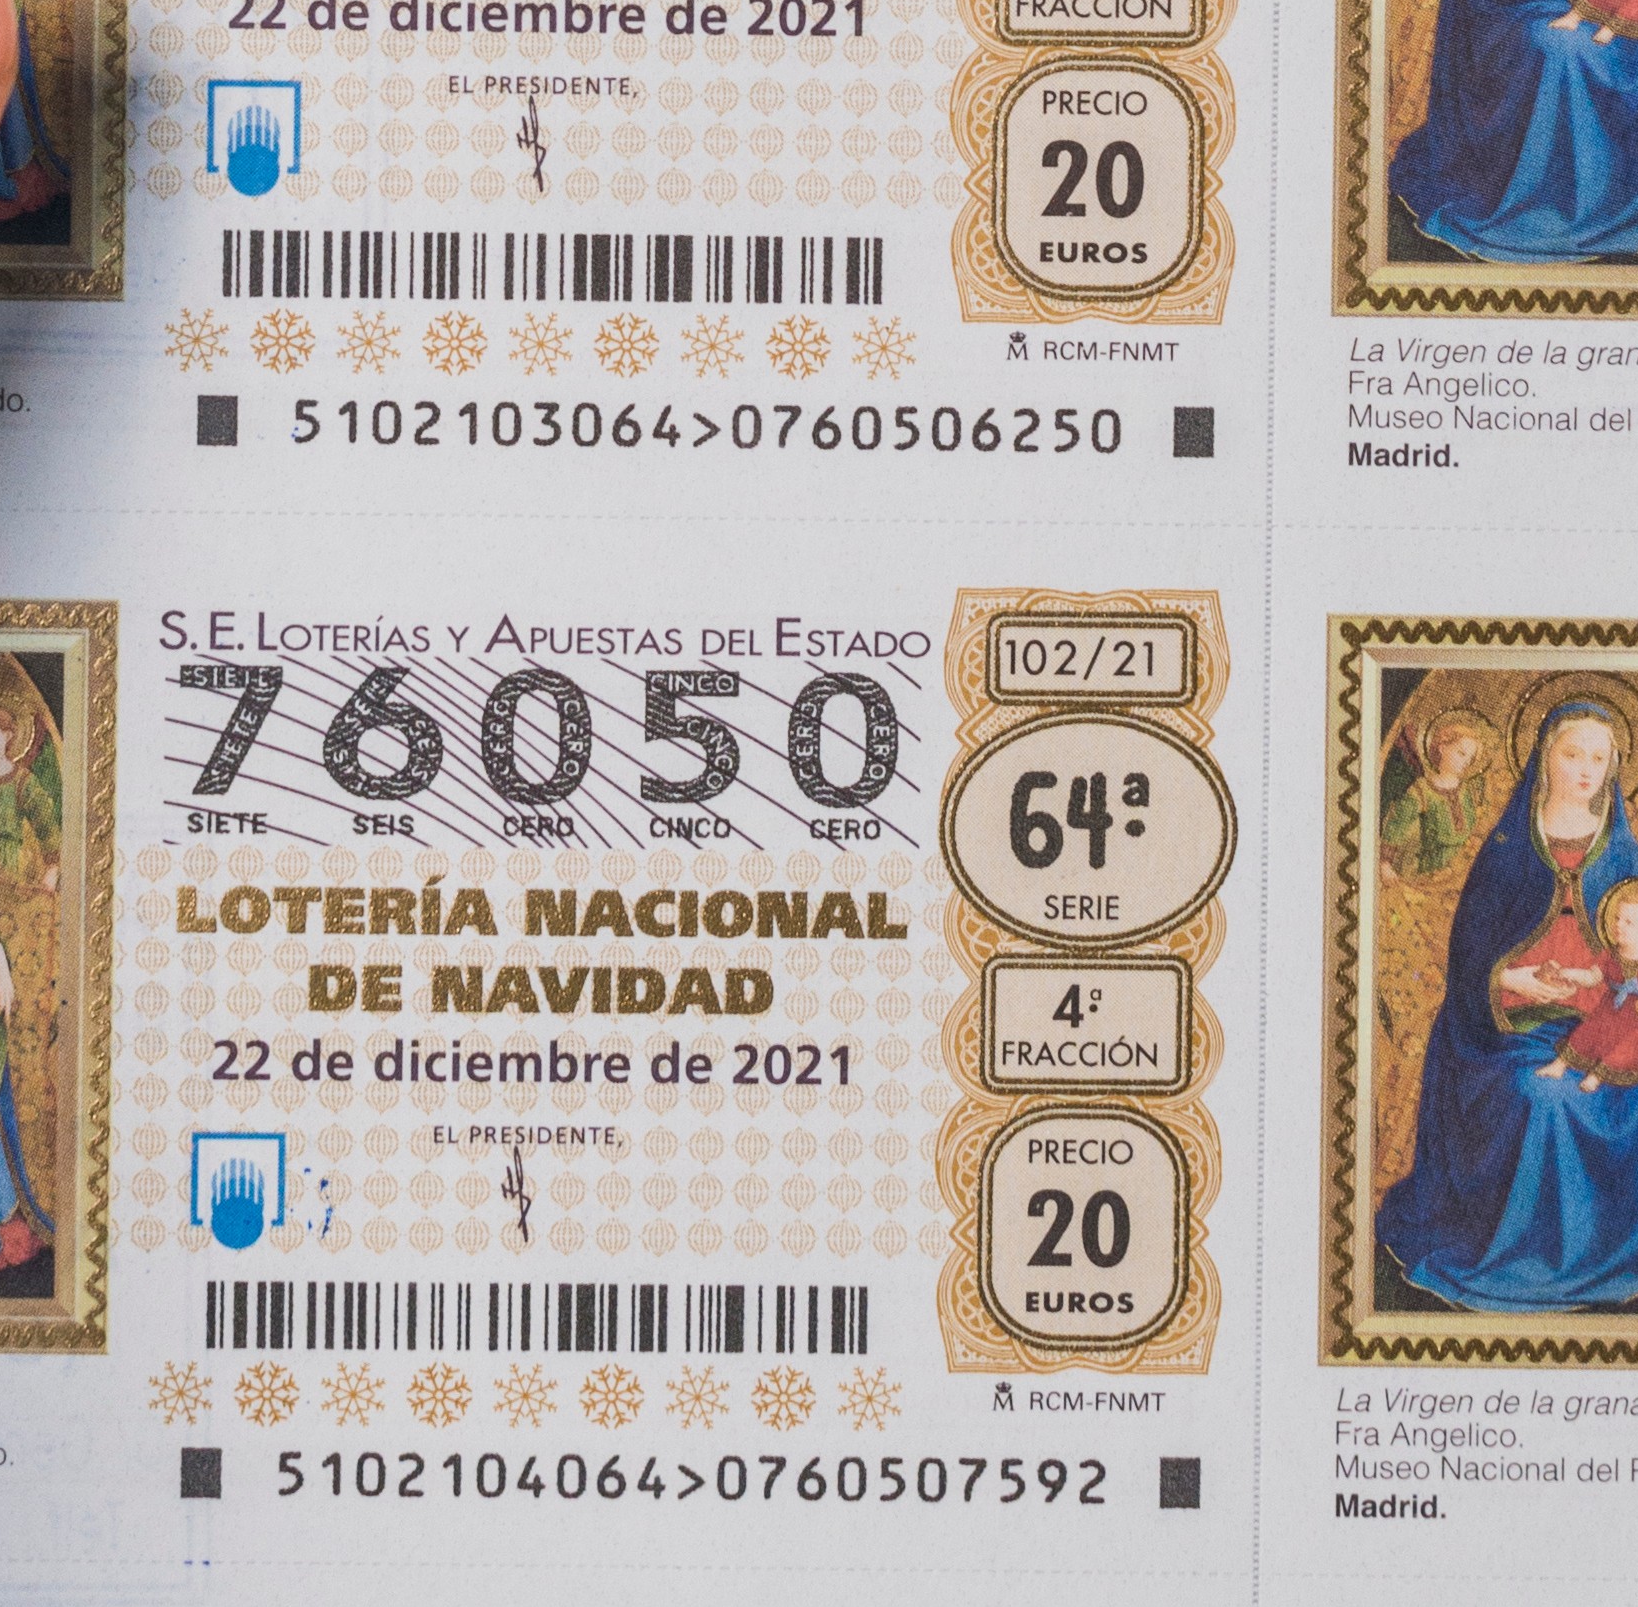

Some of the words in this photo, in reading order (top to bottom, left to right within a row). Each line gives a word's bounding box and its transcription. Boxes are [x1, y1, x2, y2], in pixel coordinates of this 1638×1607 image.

[448, 74, 474, 94] EL
[484, 75, 638, 101] PRESIDENTE,
[1041, 90, 1149, 117] PRECIO
[1039, 139, 1145, 219] 20
[1039, 241, 1148, 265] EUROS
[1042, 340, 1179, 363] RCM-FNMT
[291, 399, 1122, 455] 5102103064>0760506250
[1005, 636, 1155, 682] 102/21
[178, 663, 900, 812] 76050
[172, 873, 498, 937] LOTERÍA
[523, 886, 908, 943] NACIONAL
[307, 962, 403, 1014] DE
[430, 964, 775, 1019] NAVIDAD
[1027, 1138, 1135, 1165] PRECIO
[1025, 1189, 1131, 1269] 20
[1025, 1291, 1134, 1315] EUROS
[278, 1451, 1107, 1505] 5102104064>0760507592
